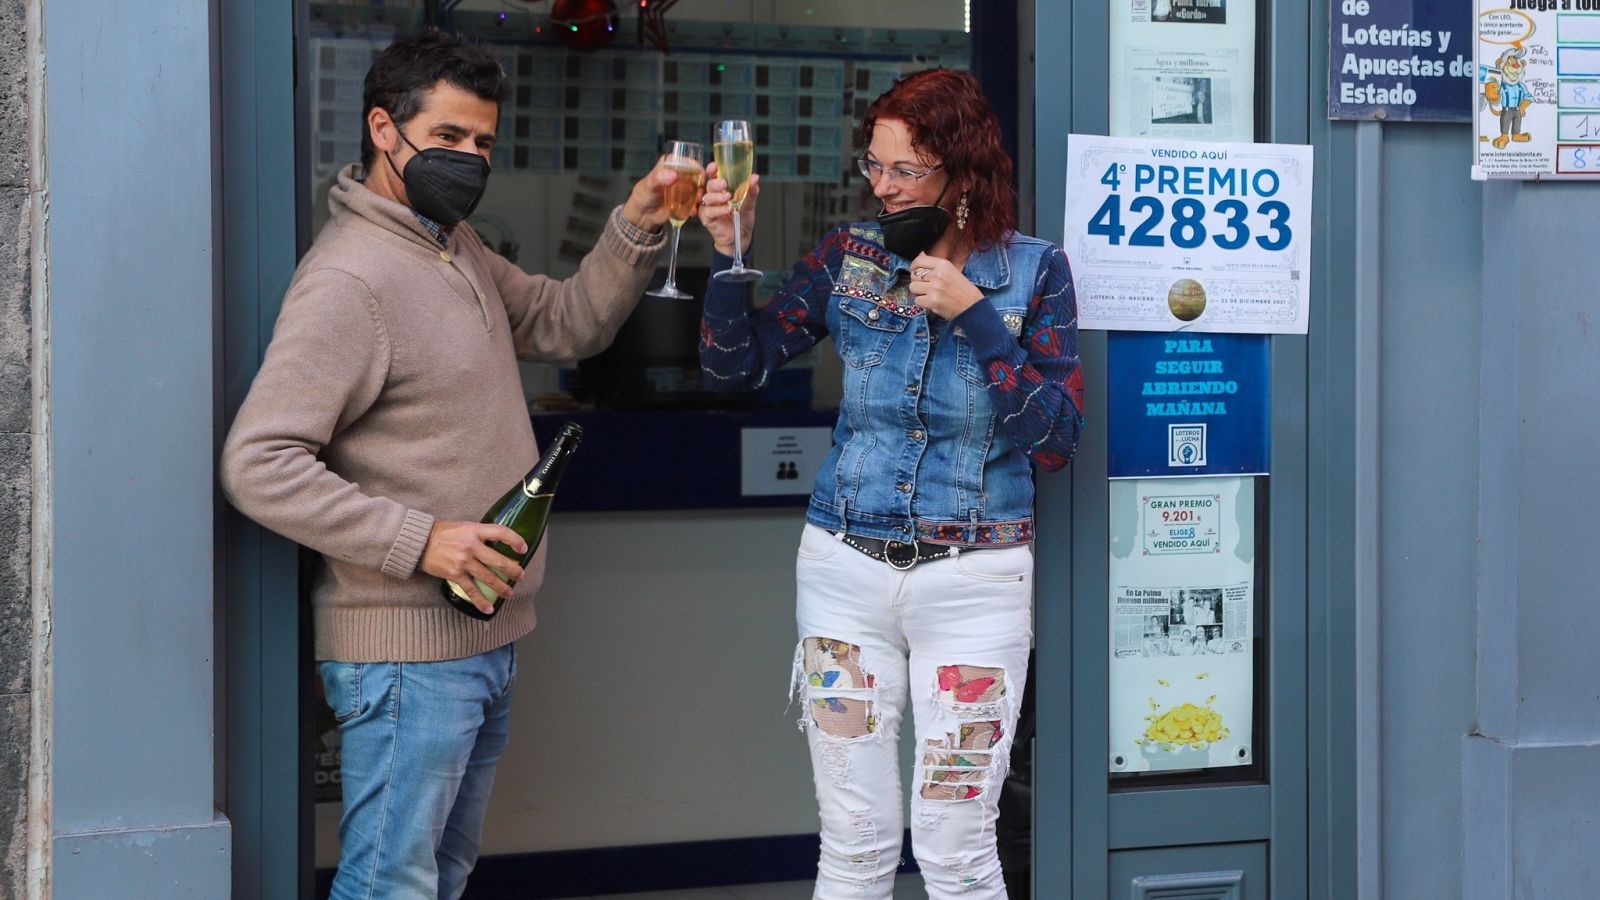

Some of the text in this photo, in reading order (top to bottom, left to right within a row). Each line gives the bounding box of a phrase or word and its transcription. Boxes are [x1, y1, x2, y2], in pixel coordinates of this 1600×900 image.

[1342, 0, 1370, 16] de
[1342, 23, 1451, 53] Loterías y
[1179, 58, 1210, 67] millones
[1341, 53, 1474, 80] Apuestas de
[1340, 82, 1417, 105] Estado
[1151, 148, 1228, 160] VENDIDO AQUÍ
[1100, 162, 1280, 197] 4º PREMIO
[1087, 194, 1292, 251] 42833
[1164, 339, 1214, 353] PARA
[1155, 360, 1224, 374] SEGUIR
[1141, 381, 1238, 395] ABRIENDO
[1146, 399, 1227, 416] MAÑANA
[1150, 500, 1212, 509] GRAN PREMIO
[1162, 511, 1194, 522] 9.201
[1190, 538, 1210, 547] AQUÍ
